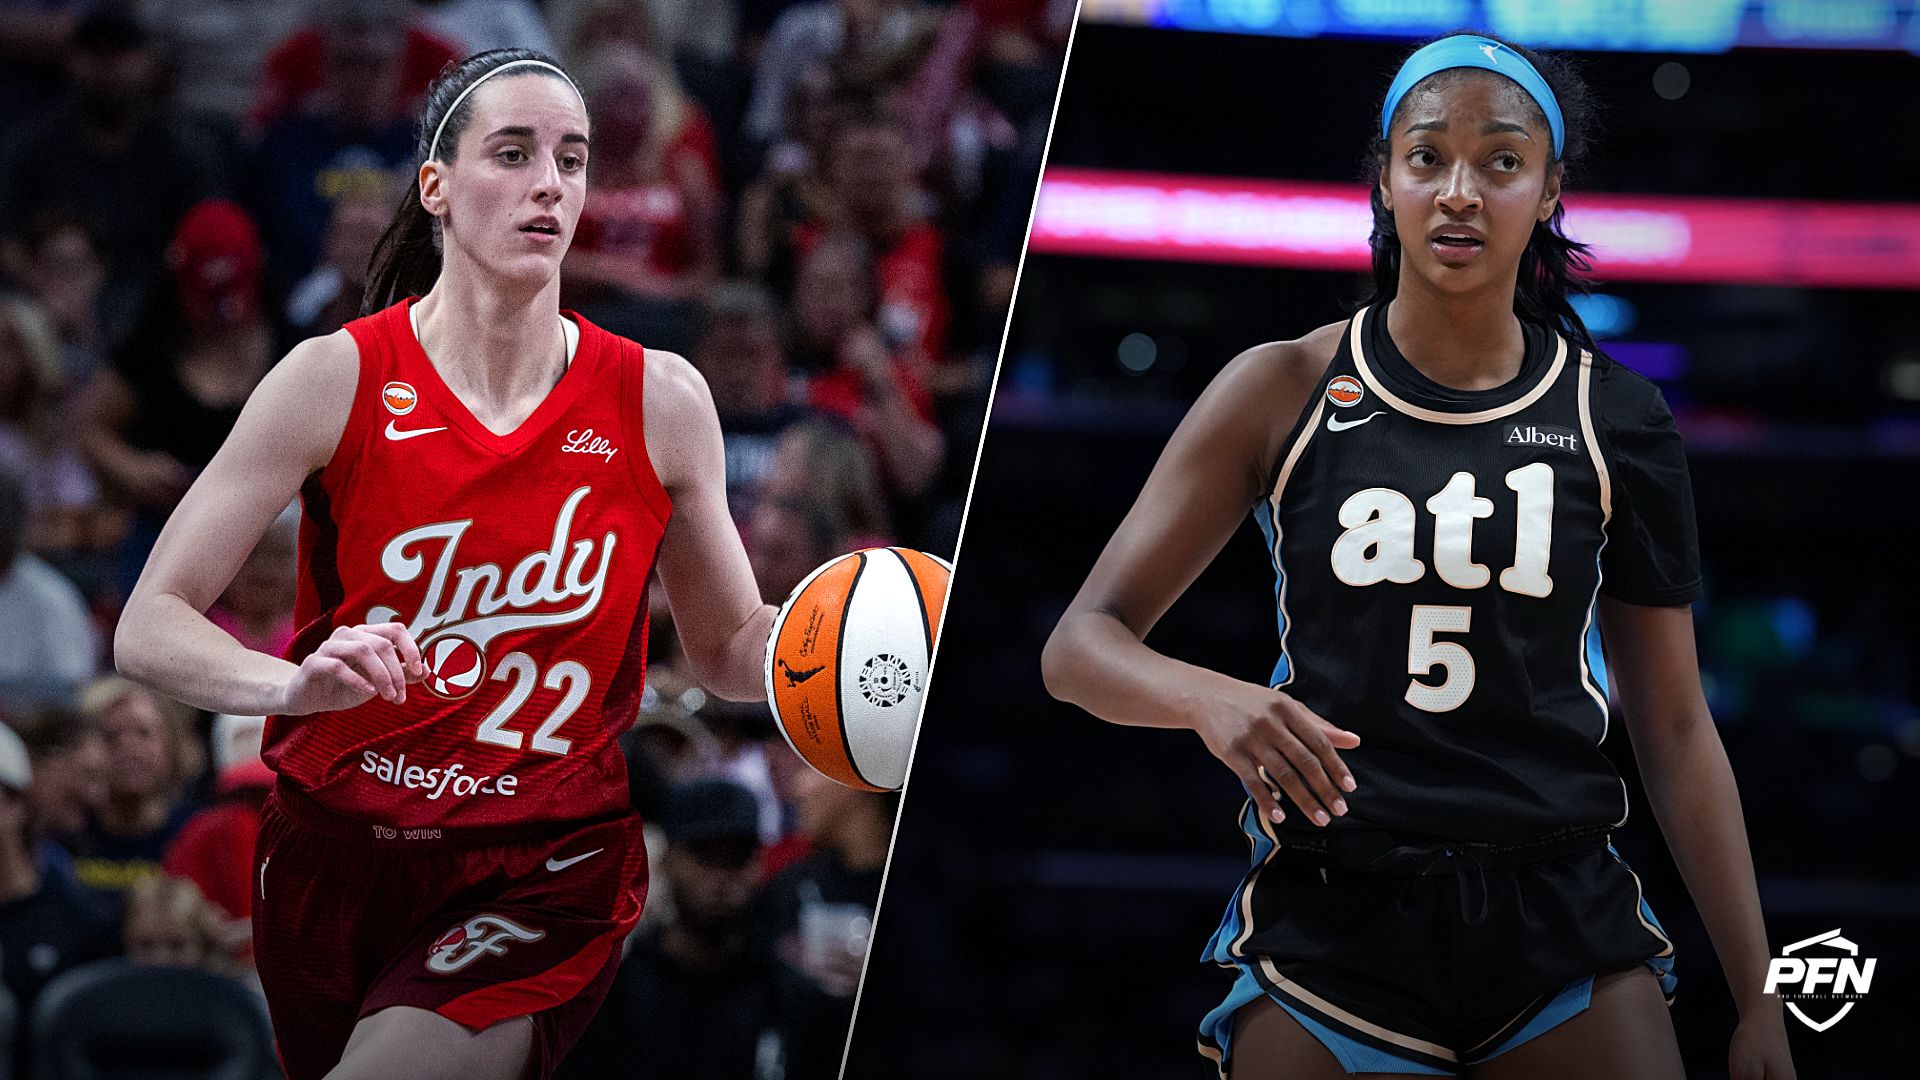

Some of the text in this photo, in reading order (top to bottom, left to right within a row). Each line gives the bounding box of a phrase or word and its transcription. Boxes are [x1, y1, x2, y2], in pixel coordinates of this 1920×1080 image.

[561, 428, 619, 464] Lilly
[1506, 425, 1579, 452] Albert
[366, 485, 617, 646] Indy
[1330, 461, 1555, 599] atl
[474, 650, 593, 757] 22
[1403, 603, 1477, 714] 5
[373, 825, 442, 841] TO WIN
